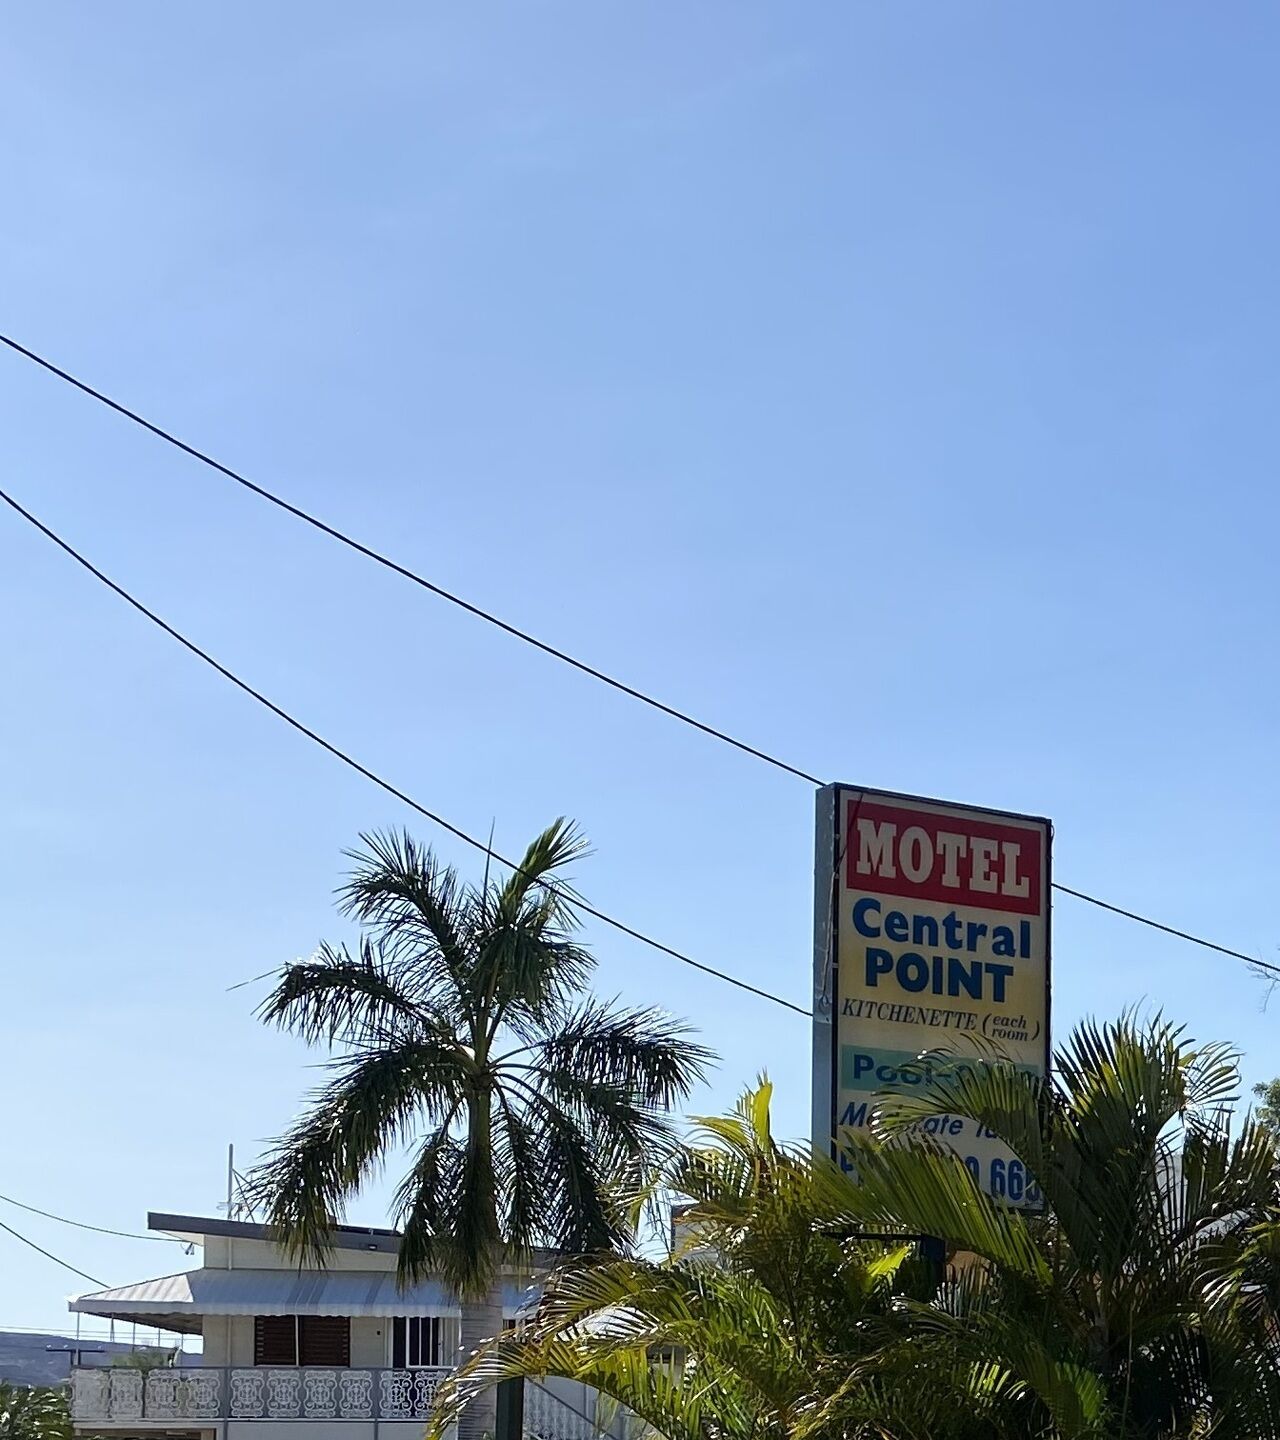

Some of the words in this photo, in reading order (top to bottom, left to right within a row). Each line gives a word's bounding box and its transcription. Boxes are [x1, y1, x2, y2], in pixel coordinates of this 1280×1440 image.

[856, 818, 1030, 898] MOTEL
[852, 898, 1031, 958] Central
[865, 948, 1014, 1003] POINT
[842, 998, 978, 1031] KITCHENETTE
